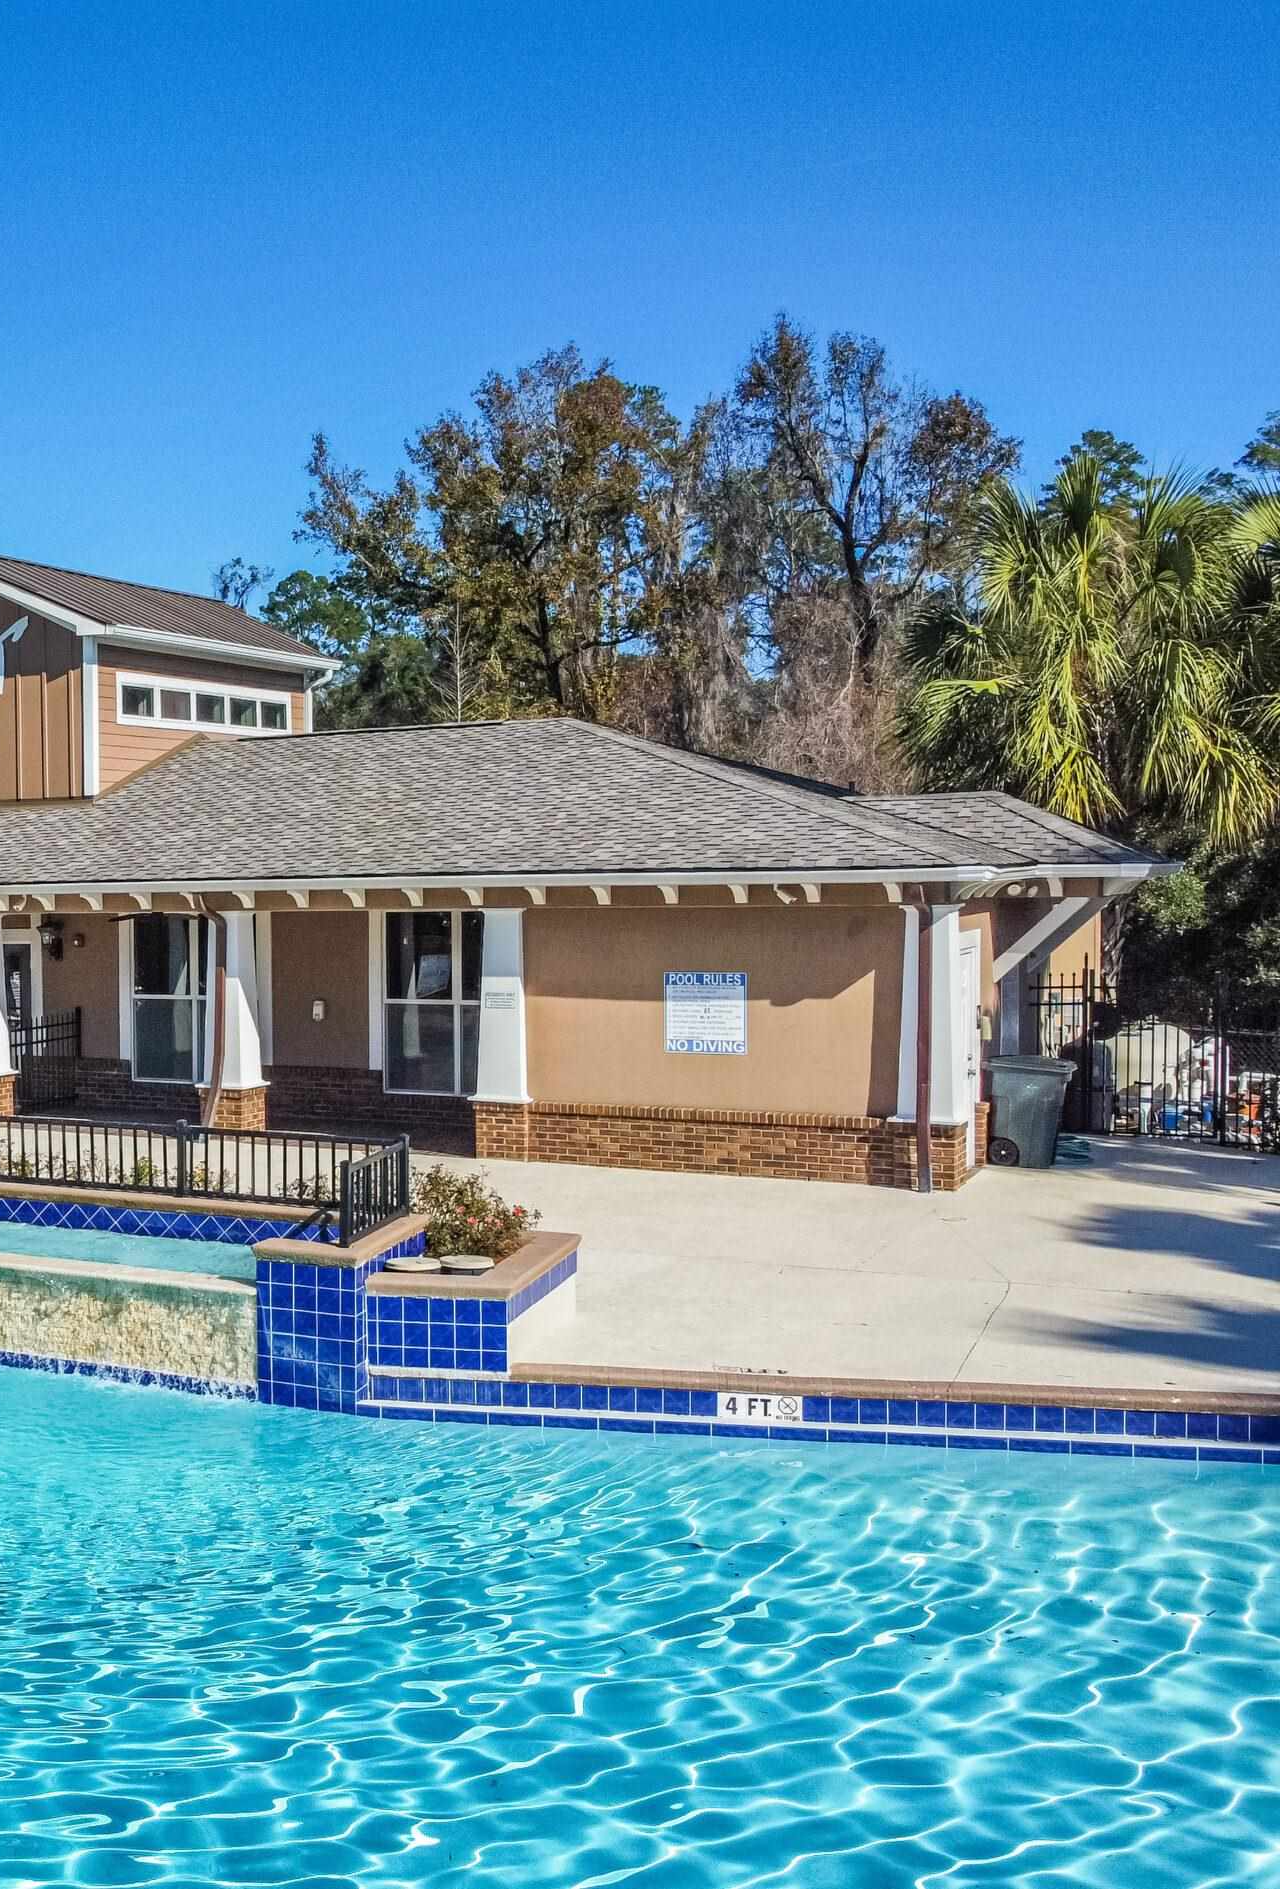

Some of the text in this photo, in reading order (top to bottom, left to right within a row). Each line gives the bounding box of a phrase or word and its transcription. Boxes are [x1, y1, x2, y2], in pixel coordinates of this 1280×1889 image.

[669, 974, 741, 986] POOL RULES
[667, 1040, 745, 1053] NO DIVING
[725, 1397, 772, 1417] 4 FT.
